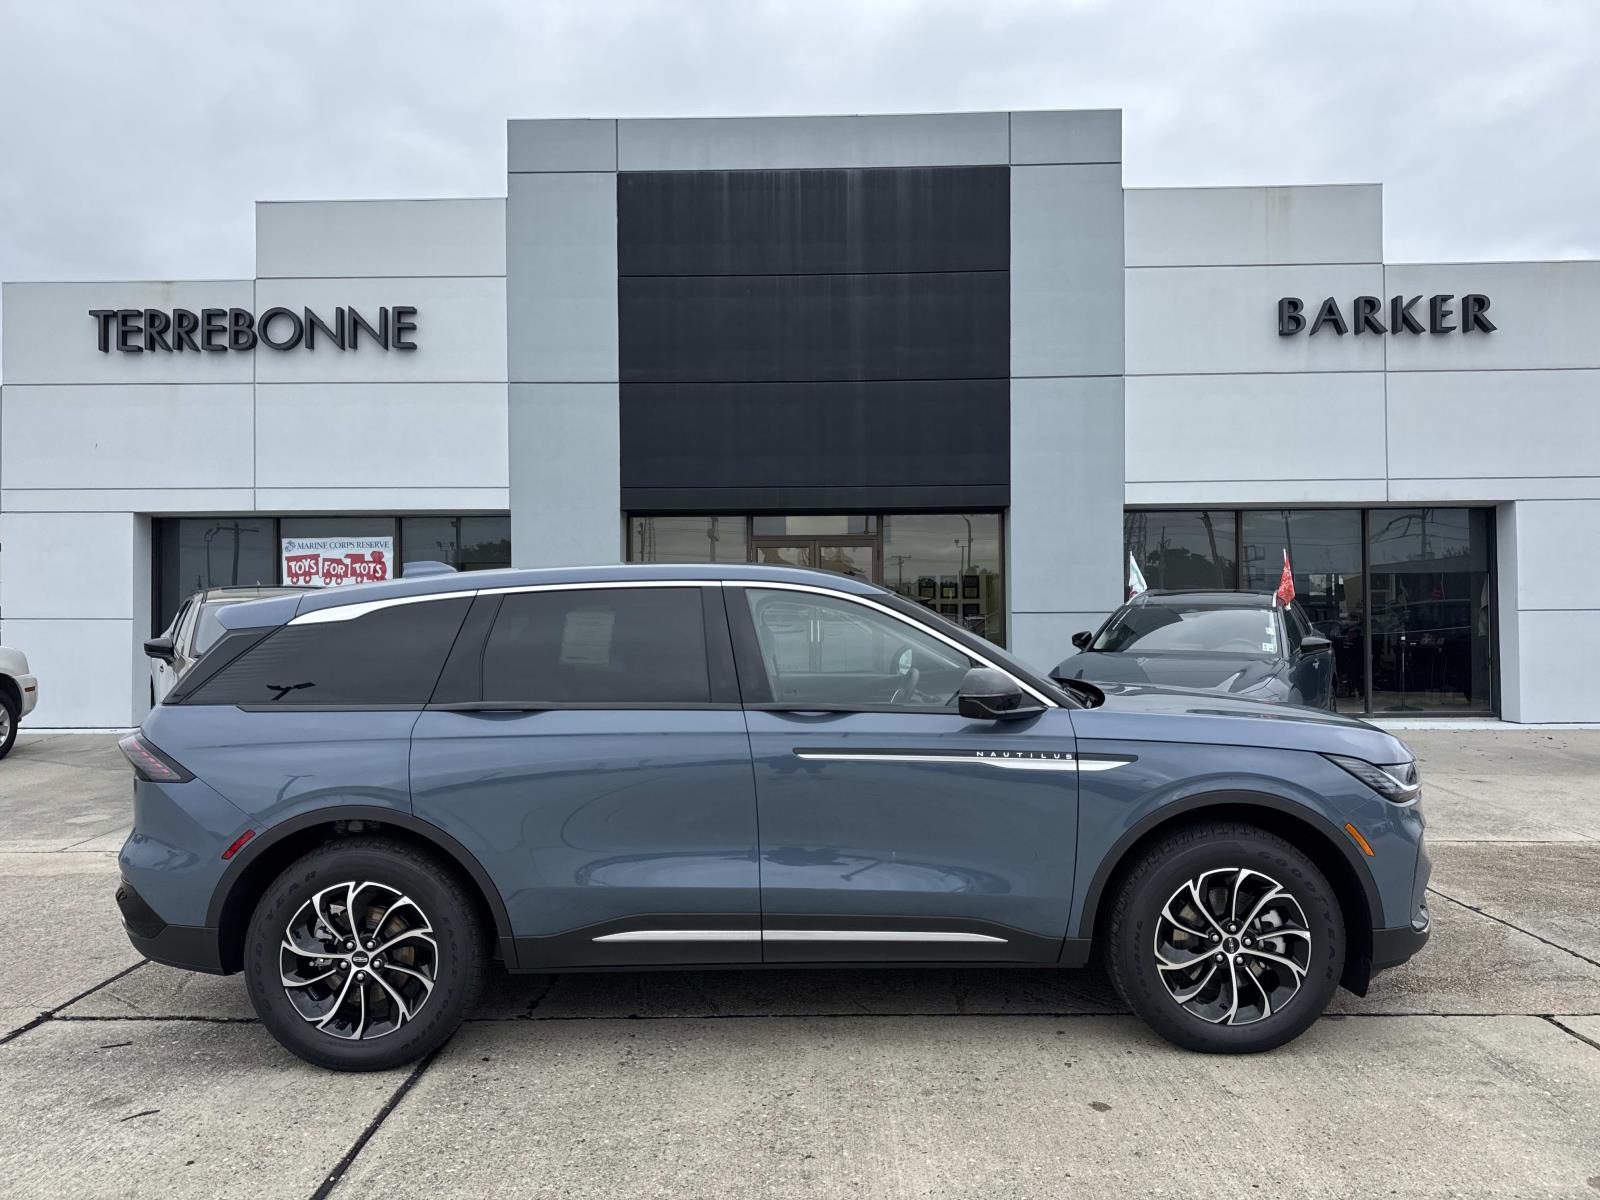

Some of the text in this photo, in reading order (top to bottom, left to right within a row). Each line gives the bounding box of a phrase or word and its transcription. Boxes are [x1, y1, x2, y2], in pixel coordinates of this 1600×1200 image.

[88, 306, 418, 352] TERREBONNE
[1278, 294, 1498, 336] BARKER
[296, 541, 327, 550] MARINE
[329, 541, 354, 549] CORPS
[288, 559, 382, 577] TOYS FOR TOTS
[976, 751, 1072, 759] NAUTILUS
[1258, 851, 1336, 979] GOODYEAR
[255, 870, 316, 1010] GOODYEAR
